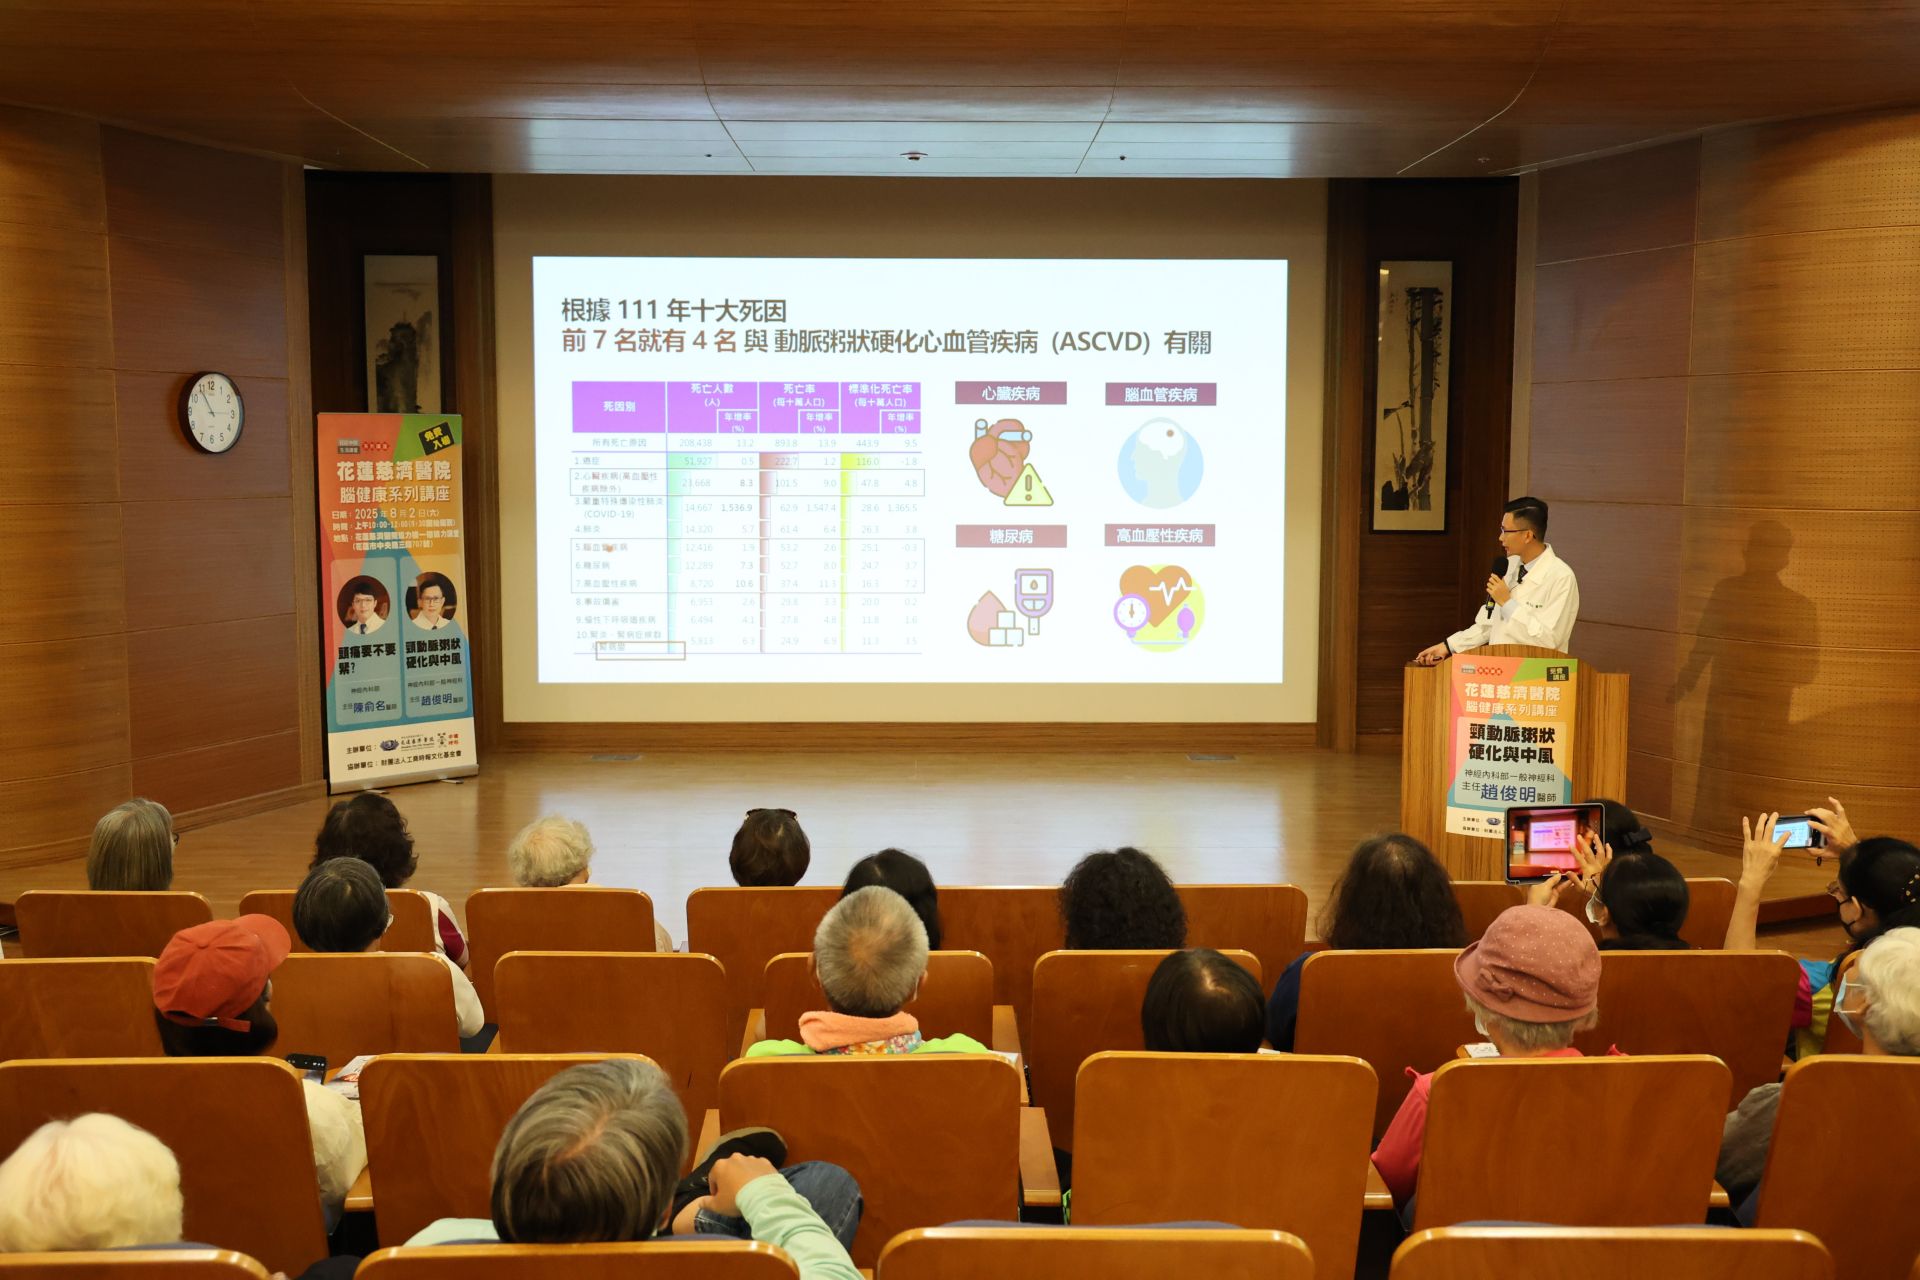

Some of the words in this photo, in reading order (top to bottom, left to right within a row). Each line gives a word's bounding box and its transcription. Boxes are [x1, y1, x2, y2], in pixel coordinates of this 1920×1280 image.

[562, 297, 611, 322] 根據
[618, 299, 658, 320] 111
[666, 297, 787, 323] 年十大死因
[562, 328, 586, 353] 前
[596, 330, 605, 350] 7
[614, 328, 686, 353] 名就有
[693, 330, 707, 350] 4
[714, 328, 737, 353] 名
[744, 329, 769, 353] 與
[774, 328, 1038, 354] 動脈粥狀硬化心血管疾病
[1052, 331, 1150, 355] (ASCVD)
[1164, 329, 1212, 354] 有關
[208, 381, 215, 390] 12
[690, 384, 734, 394] 死亡人數
[783, 384, 815, 394] 死亡率
[848, 384, 913, 394] 標準化死亡率
[982, 386, 1041, 402] 心臟疾病
[1125, 386, 1198, 403] 腦血管疾病
[192, 394, 198, 403] 10
[227, 395, 231, 403] 2
[603, 401, 636, 412] 死因別
[231, 410, 235, 419] 3
[227, 424, 231, 432] 4
[200, 433, 204, 441] 7
[210, 435, 214, 444] 6
[220, 433, 224, 441] 5
[593, 439, 647, 447] 所有死亡原因
[680, 439, 712, 447] 208,438
[737, 439, 754, 447] 13.2
[775, 439, 798, 447] 893.8
[819, 439, 836, 447] 13.9
[856, 439, 879, 447] 443.9
[904, 439, 917, 447] 9.5
[685, 457, 712, 465] 51,927
[742, 457, 754, 465] 0.5
[776, 457, 797, 465] 222.7
[824, 457, 836, 465] 1.2
[857, 457, 879, 465] 116.0
[901, 457, 917, 465] -1.8
[337, 461, 451, 481] 花蓮慈濟醫院
[682, 479, 711, 487] 23,668
[740, 479, 753, 487] 8.3
[776, 479, 798, 487] 101.5
[824, 479, 836, 487] 9.0
[861, 479, 879, 487] 47.8
[905, 479, 917, 487] 4.8
[340, 486, 450, 503] 腦健康系列講座
[685, 504, 712, 512] 14,667
[721, 504, 752, 512] 1,536.9
[807, 504, 836, 512] 1,547.4
[888, 504, 917, 512] 1,365.5
[355, 509, 378, 518] 2025
[390, 509, 396, 518] 8
[409, 508, 415, 518] 2
[584, 510, 635, 519] (COVID-19)
[990, 529, 1034, 545] 糖尿病
[1116, 528, 1203, 544] 高血壓性疾病
[406, 638, 461, 654] 頸動脈粥狀
[339, 643, 396, 660] 頭痛要不要
[406, 655, 462, 669] 硬化與中風
[1465, 683, 1560, 701] 花蓮慈濟醫院
[1466, 700, 1558, 717] 腦健康系列講座
[1470, 723, 1555, 743] 頸動脈粥狀
[1469, 743, 1554, 764] 硬化與中風
[1465, 769, 1555, 782] 神經內科部一般神經科
[1462, 781, 1557, 803] 主任趙俊明醫師
